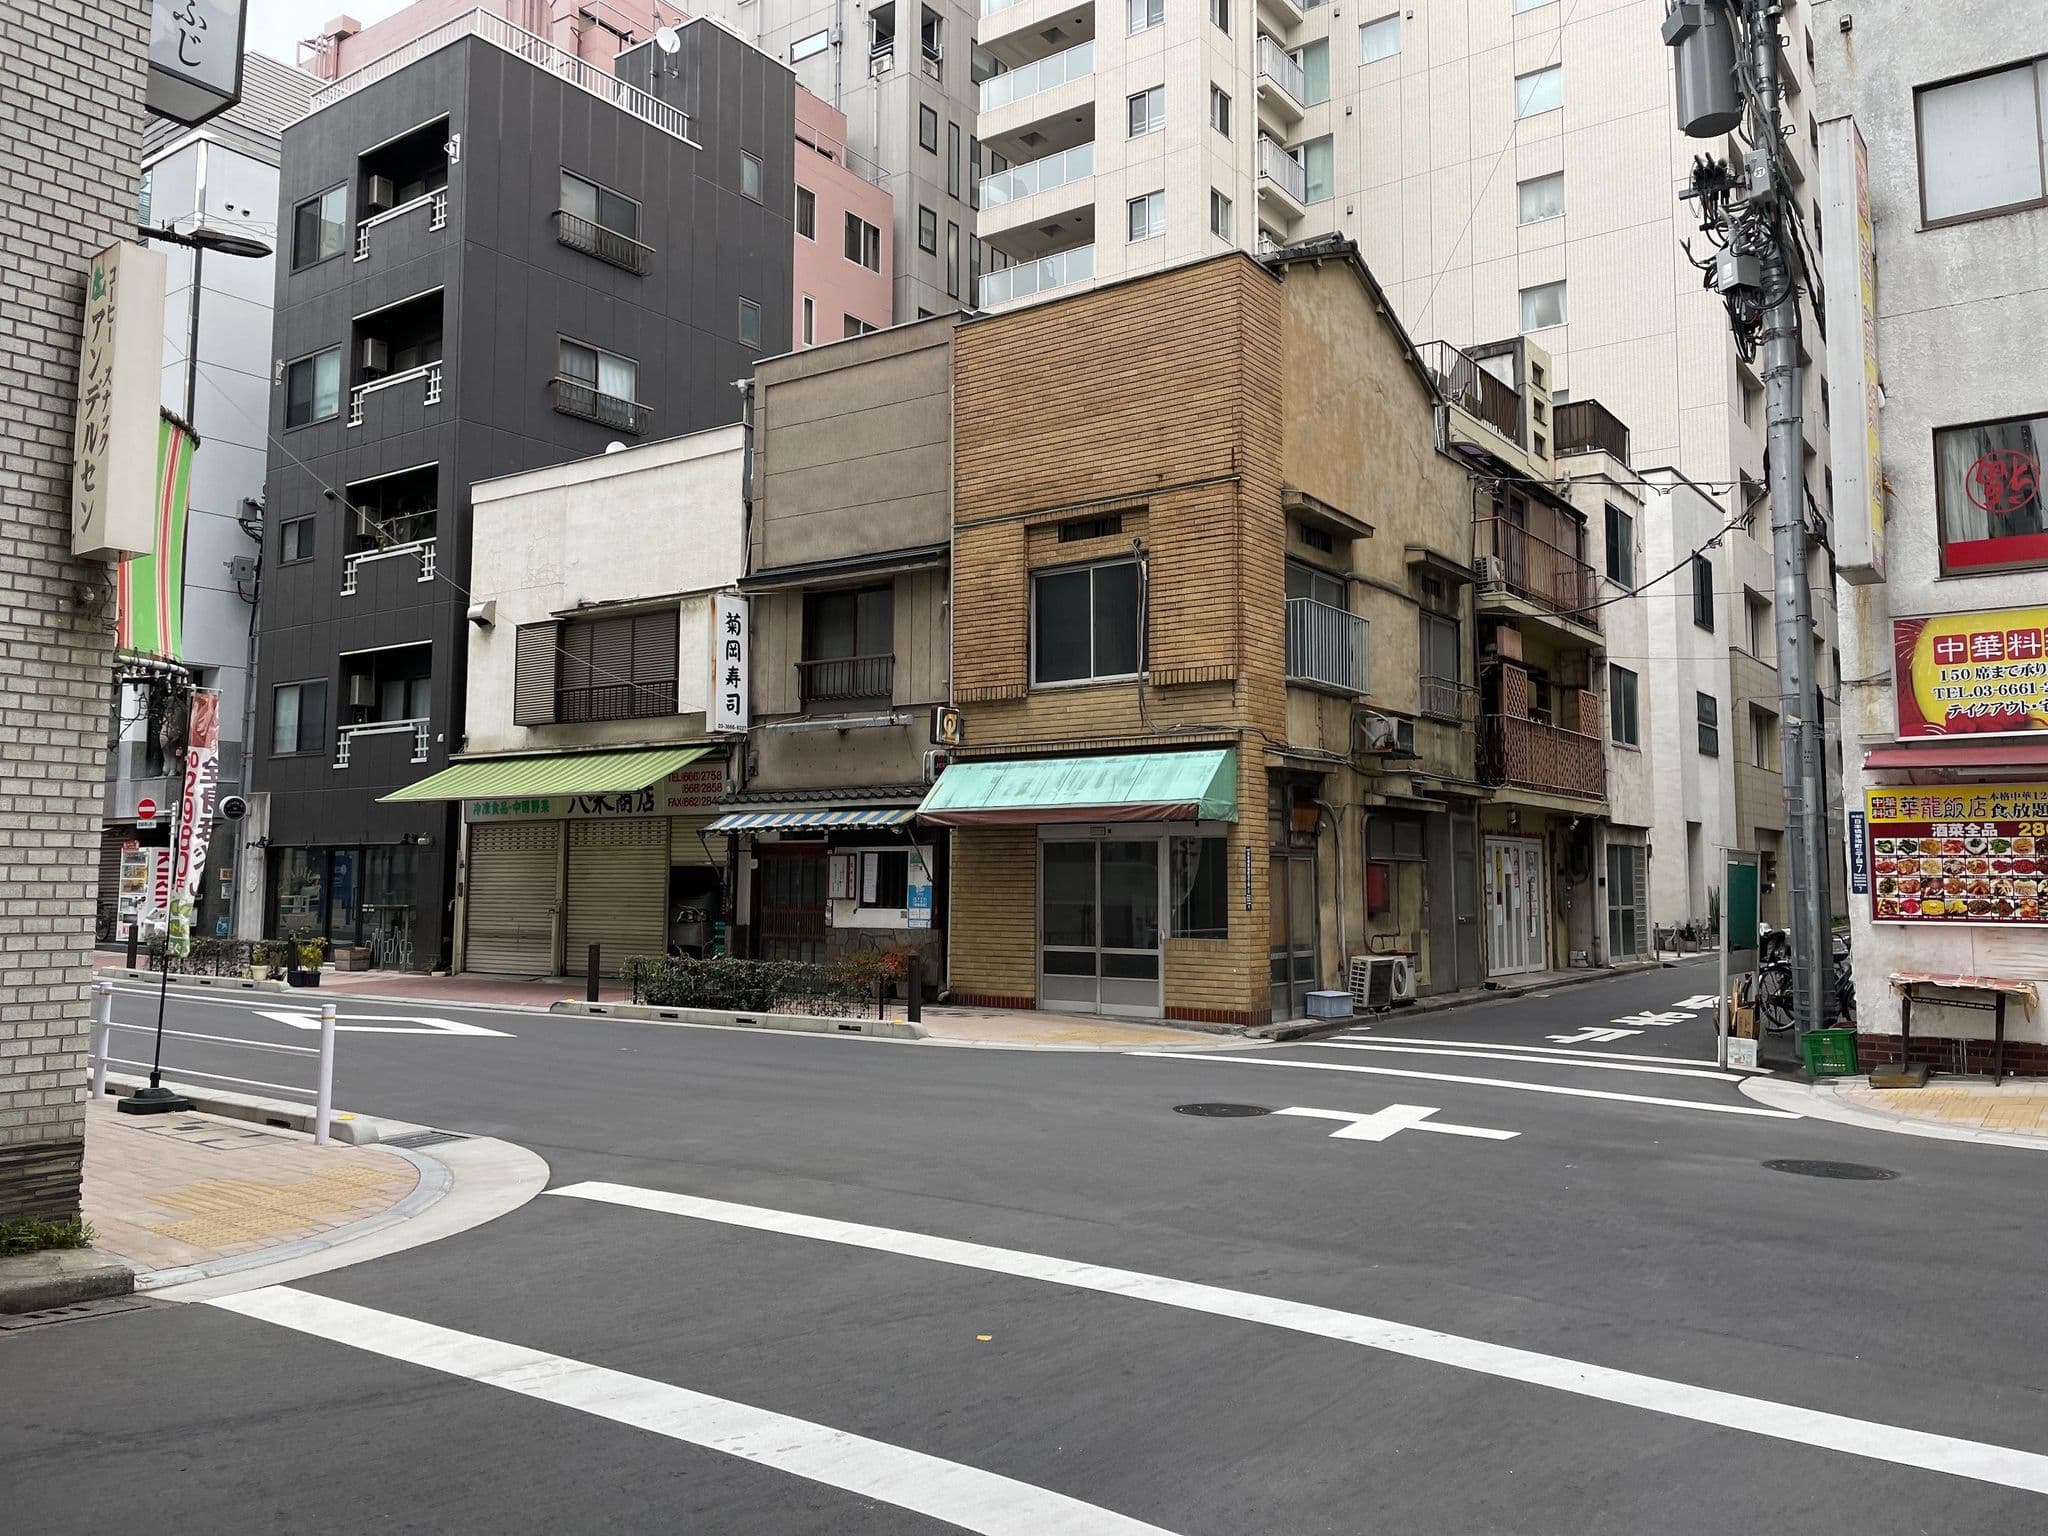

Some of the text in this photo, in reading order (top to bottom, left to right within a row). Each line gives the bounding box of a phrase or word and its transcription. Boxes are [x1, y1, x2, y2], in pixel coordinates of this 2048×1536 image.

[107, 266, 117, 343] コーヒー
[81, 308, 105, 533] アンデルセン
[98, 366, 115, 457] スナック
[1937, 631, 2048, 663] 中華料
[725, 611, 742, 716] 菊岡寿司
[1933, 682, 2048, 700] TEL.03-6661-
[1900, 795, 1987, 819] 華龍飯店
[1931, 821, 1998, 838] 酒菜全品
[2018, 822, 2048, 838] 28
